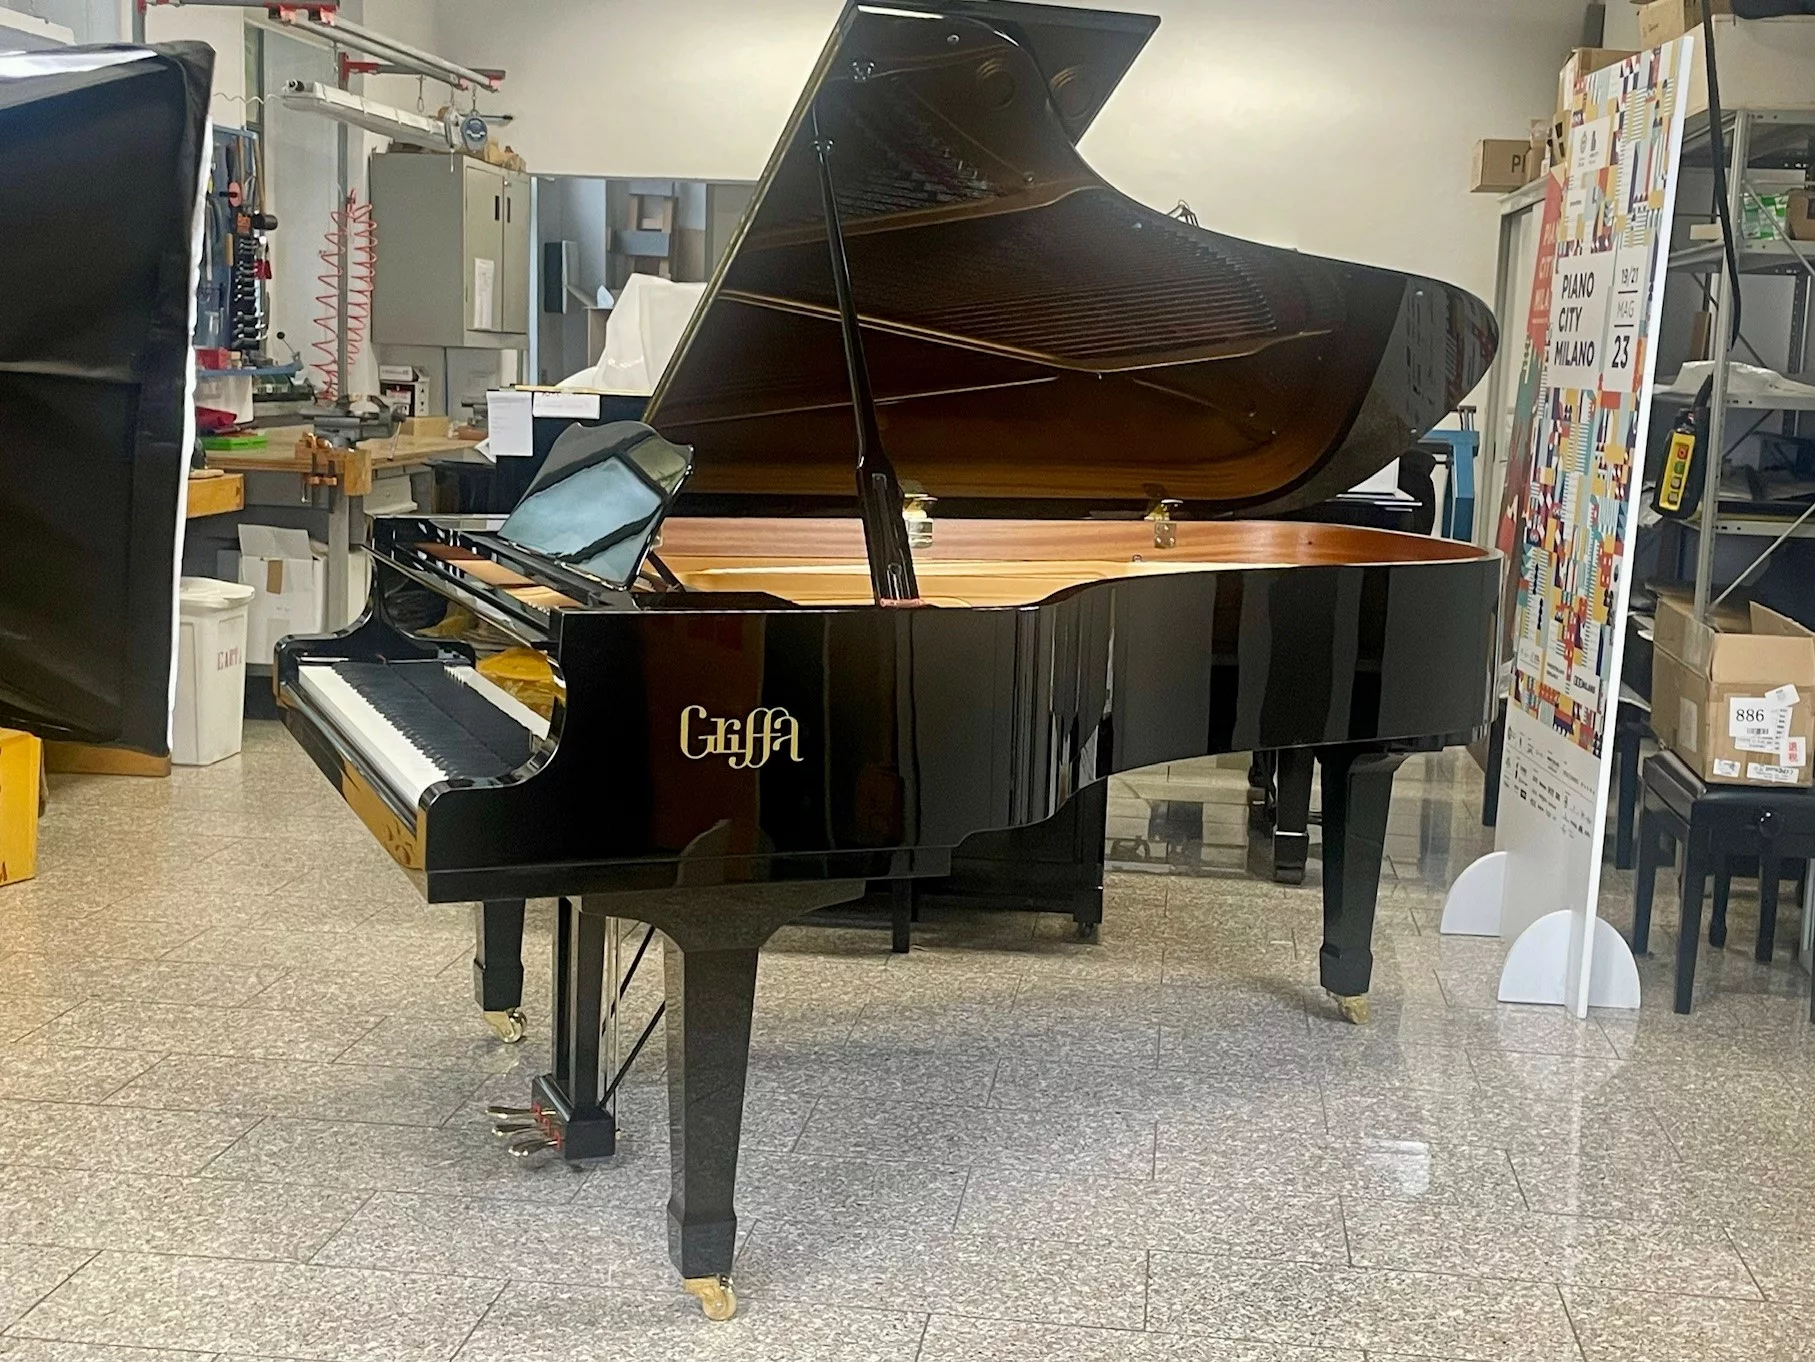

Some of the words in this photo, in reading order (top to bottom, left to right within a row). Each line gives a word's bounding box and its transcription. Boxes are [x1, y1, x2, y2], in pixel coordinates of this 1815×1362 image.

[1511, 154, 1526, 173] PI
[1562, 271, 1595, 299] PIANO
[1558, 306, 1583, 333] CITY
[1617, 300, 1634, 319] MAG
[1554, 340, 1595, 367] MILANO
[1611, 335, 1630, 369] 23
[1736, 708, 1765, 723] 886
[680, 705, 804, 769] Griffa
